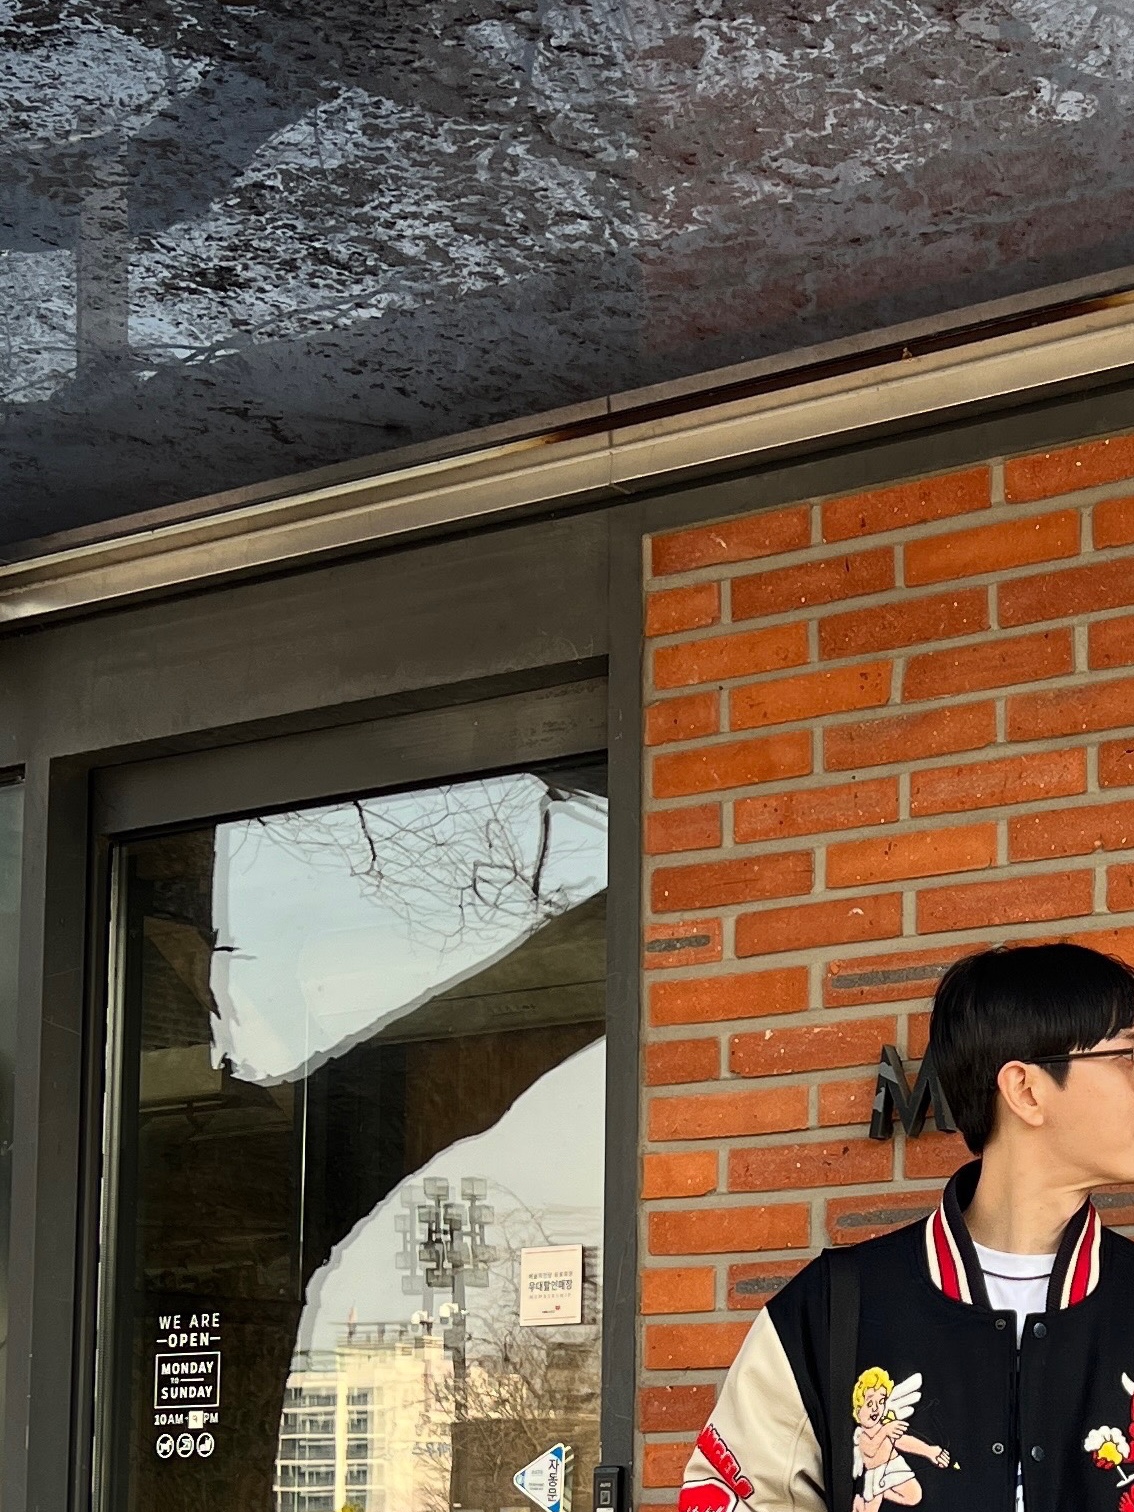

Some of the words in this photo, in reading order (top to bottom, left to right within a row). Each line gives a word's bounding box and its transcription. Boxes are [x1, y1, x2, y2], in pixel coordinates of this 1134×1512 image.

[158, 1315, 181, 1330] WE
[189, 1312, 220, 1329] ARE
[161, 1361, 214, 1375] MONDAY
[161, 1385, 213, 1400] SUNDAY
[547, 1458, 560, 1502] 자동문
